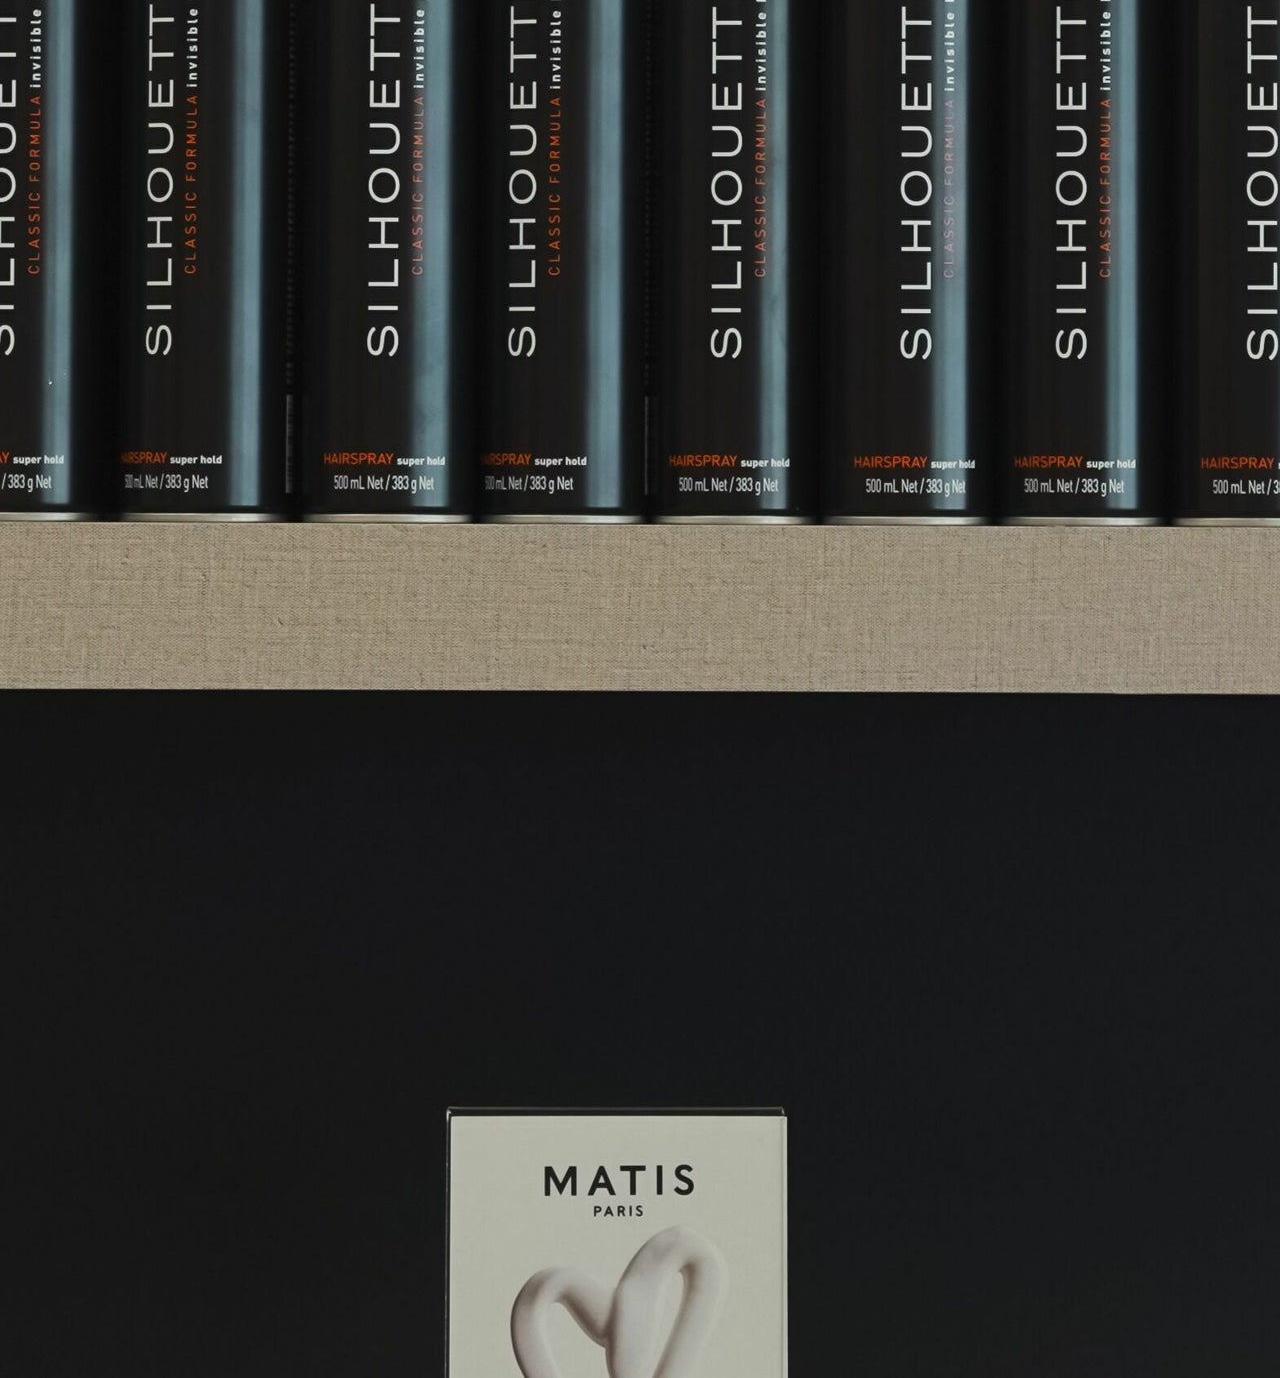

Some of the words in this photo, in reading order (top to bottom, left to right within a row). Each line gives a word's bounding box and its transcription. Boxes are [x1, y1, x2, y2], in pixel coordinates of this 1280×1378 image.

[29, 9, 41, 88] invisible
[185, 9, 198, 88] invisible
[413, 9, 424, 88] invisible
[549, 10, 561, 89] invisible
[754, 12, 766, 90] invisible
[944, 13, 954, 91] invisible
[1099, 12, 1111, 90] invisible
[28, 96, 41, 182] FORMULA
[185, 96, 197, 182] FORMULA
[412, 96, 423, 182] FORMULA
[548, 97, 561, 183] FORMULA
[754, 99, 767, 185] FORMULA
[944, 101, 953, 185] FORMULA
[1099, 99, 1111, 185] FORMULA
[27, 192, 40, 274] CLASSIC
[183, 192, 197, 274] CLASSIC
[411, 193, 423, 275] CLASSIC
[547, 194, 560, 276] CLASSIC
[754, 196, 766, 277] CLASSIC
[943, 197, 953, 277] CLASSIC
[1098, 196, 1111, 278] CLASSIC
[8, 474, 25, 488] 383
[27, 478, 33, 492] g
[36, 474, 52, 489] Net
[13, 457, 42, 466] super
[44, 455, 64, 464] hold
[170, 457, 198, 466] super
[200, 455, 222, 464] hold
[324, 452, 394, 464] HAIRSPRAY
[397, 458, 425, 467] super
[427, 457, 445, 465] hold
[334, 475, 348, 489] 500
[350, 475, 365, 489] mL
[367, 475, 384, 490] Net
[392, 475, 409, 490] 383
[411, 479, 417, 494] g
[419, 476, 434, 490] Net
[534, 458, 563, 467] super
[565, 456, 587, 465] hold
[669, 454, 737, 466] HAIRSPRAY
[741, 460, 769, 469] super
[771, 458, 790, 467] hold
[679, 477, 693, 491] 500
[695, 478, 709, 491] mL
[711, 478, 728, 491] Net
[736, 477, 753, 492] 383
[755, 481, 761, 496] g
[762, 478, 778, 491] Net
[854, 456, 927, 468] HAIRSPRAY
[931, 461, 957, 470] super
[959, 460, 975, 469] hold
[866, 478, 881, 493] 500
[884, 479, 899, 493] mL
[901, 479, 918, 493] Net
[926, 479, 943, 493] 383
[944, 483, 951, 497] g
[952, 479, 966, 493] Net
[1015, 456, 1083, 468] HAIRSPRAY
[1086, 461, 1115, 470] super
[1117, 459, 1136, 468] hold
[1024, 478, 1038, 492] 500
[1040, 479, 1055, 493] mL
[1057, 479, 1073, 493] Net
[1081, 478, 1099, 493] 383
[1101, 483, 1108, 497] g
[1109, 479, 1124, 493] Net
[1201, 457, 1274, 469] HAIRSPRAY
[1213, 479, 1228, 494] 500
[1231, 480, 1246, 494] mL
[1248, 480, 1265, 494] Net
[544, 1164, 695, 1196] MATIS
[593, 1205, 644, 1217] PARIS
